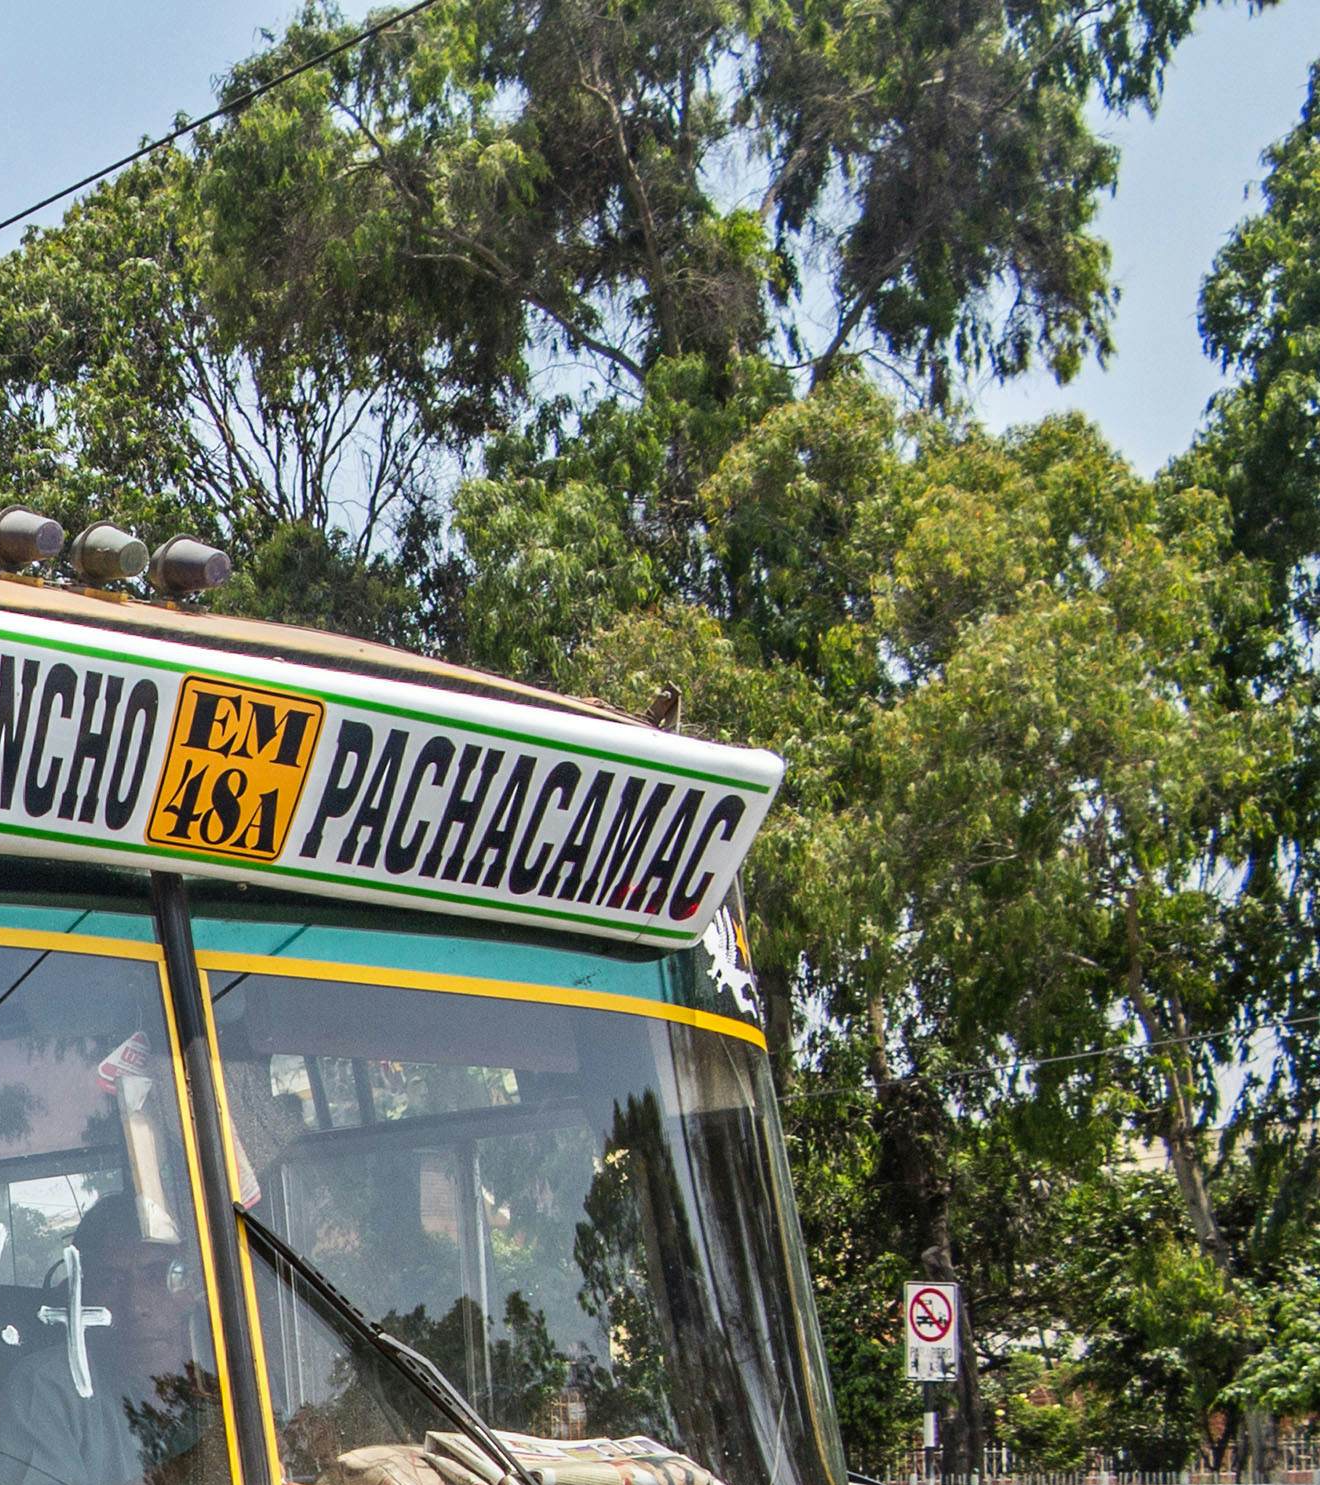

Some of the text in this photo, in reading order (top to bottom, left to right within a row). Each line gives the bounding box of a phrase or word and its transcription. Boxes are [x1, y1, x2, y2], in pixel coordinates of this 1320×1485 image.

[188, 690, 305, 769] EM
[161, 760, 280, 854] 48A
[297, 720, 747, 922] PACHACAMAC
